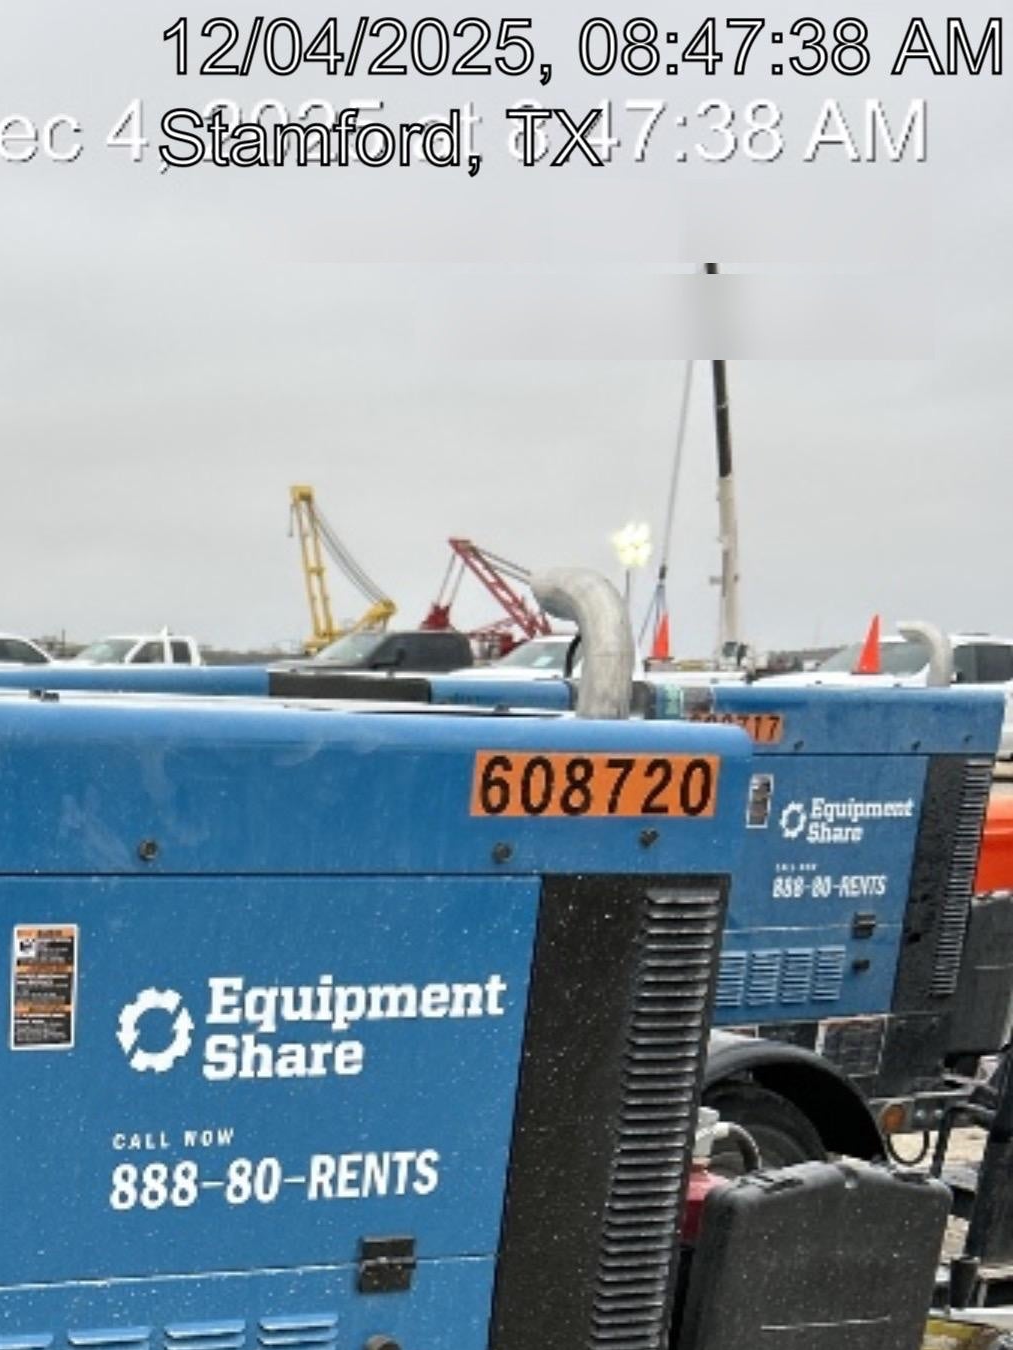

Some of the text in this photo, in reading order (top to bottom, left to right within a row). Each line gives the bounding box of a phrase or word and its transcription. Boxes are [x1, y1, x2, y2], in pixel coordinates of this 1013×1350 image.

[480, 754, 714, 816] 608720
[806, 821, 863, 844] Share
[810, 797, 914, 822] Equipment
[206, 974, 507, 1033] Equipment
[202, 1034, 365, 1081] Share
[112, 1128, 235, 1151] CALL NOW
[109, 1149, 441, 1210] 888-80-RENTS
